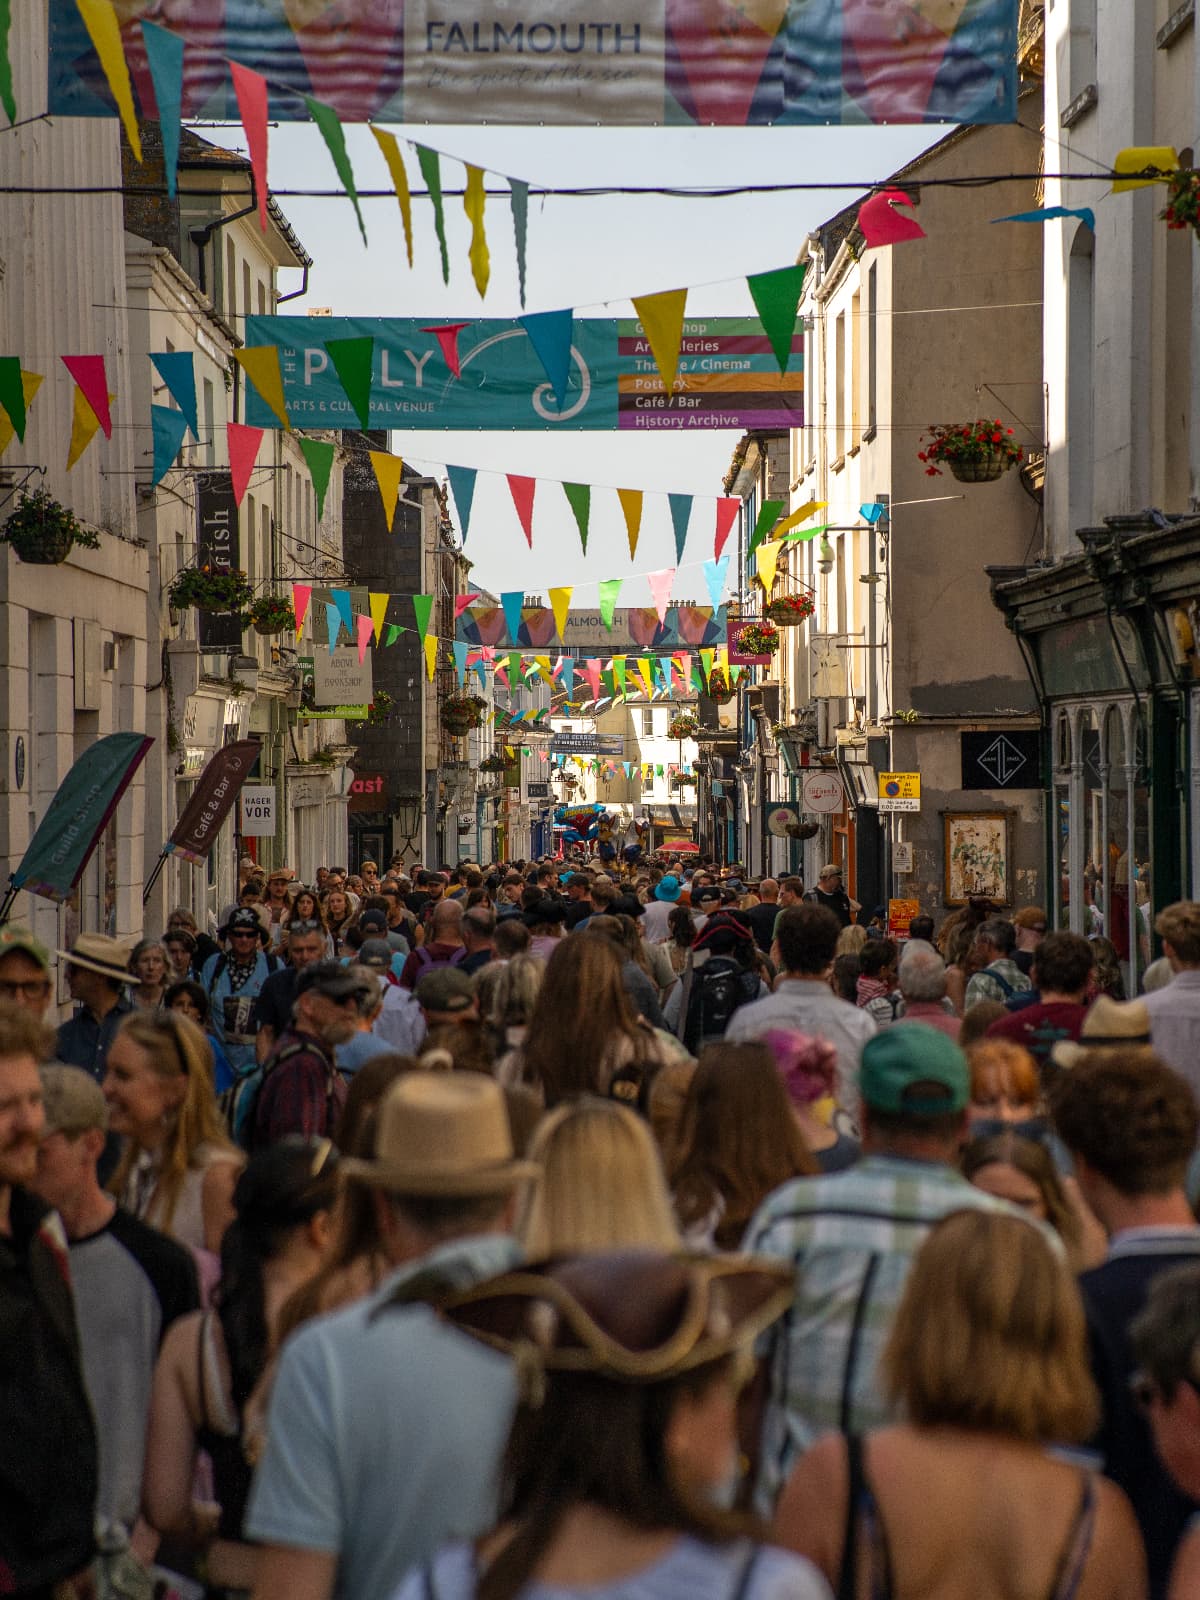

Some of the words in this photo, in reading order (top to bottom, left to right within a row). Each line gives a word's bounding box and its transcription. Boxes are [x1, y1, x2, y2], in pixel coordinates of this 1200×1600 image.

[426, 22, 641, 53] FALMOUTH
[601, 68, 638, 80] sea
[682, 322, 707, 335] hop
[634, 341, 650, 352] Ar
[284, 348, 296, 384] THE
[304, 348, 434, 388] PLY
[635, 359, 687, 371] Thee
[701, 359, 751, 370] Cinema
[635, 379, 686, 391] Pottry
[285, 400, 315, 411] ARTS
[319, 401, 326, 411] &
[330, 401, 392, 412] CULRAL
[395, 402, 435, 412] VENUE
[635, 396, 664, 408] Café
[678, 397, 701, 408] Bar
[636, 415, 684, 428] History
[688, 414, 739, 426] Archive
[352, 776, 383, 793] ast
[194, 812, 214, 839] Café
[208, 801, 220, 811] &
[214, 776, 230, 798] Bar
[246, 807, 271, 818] VOR
